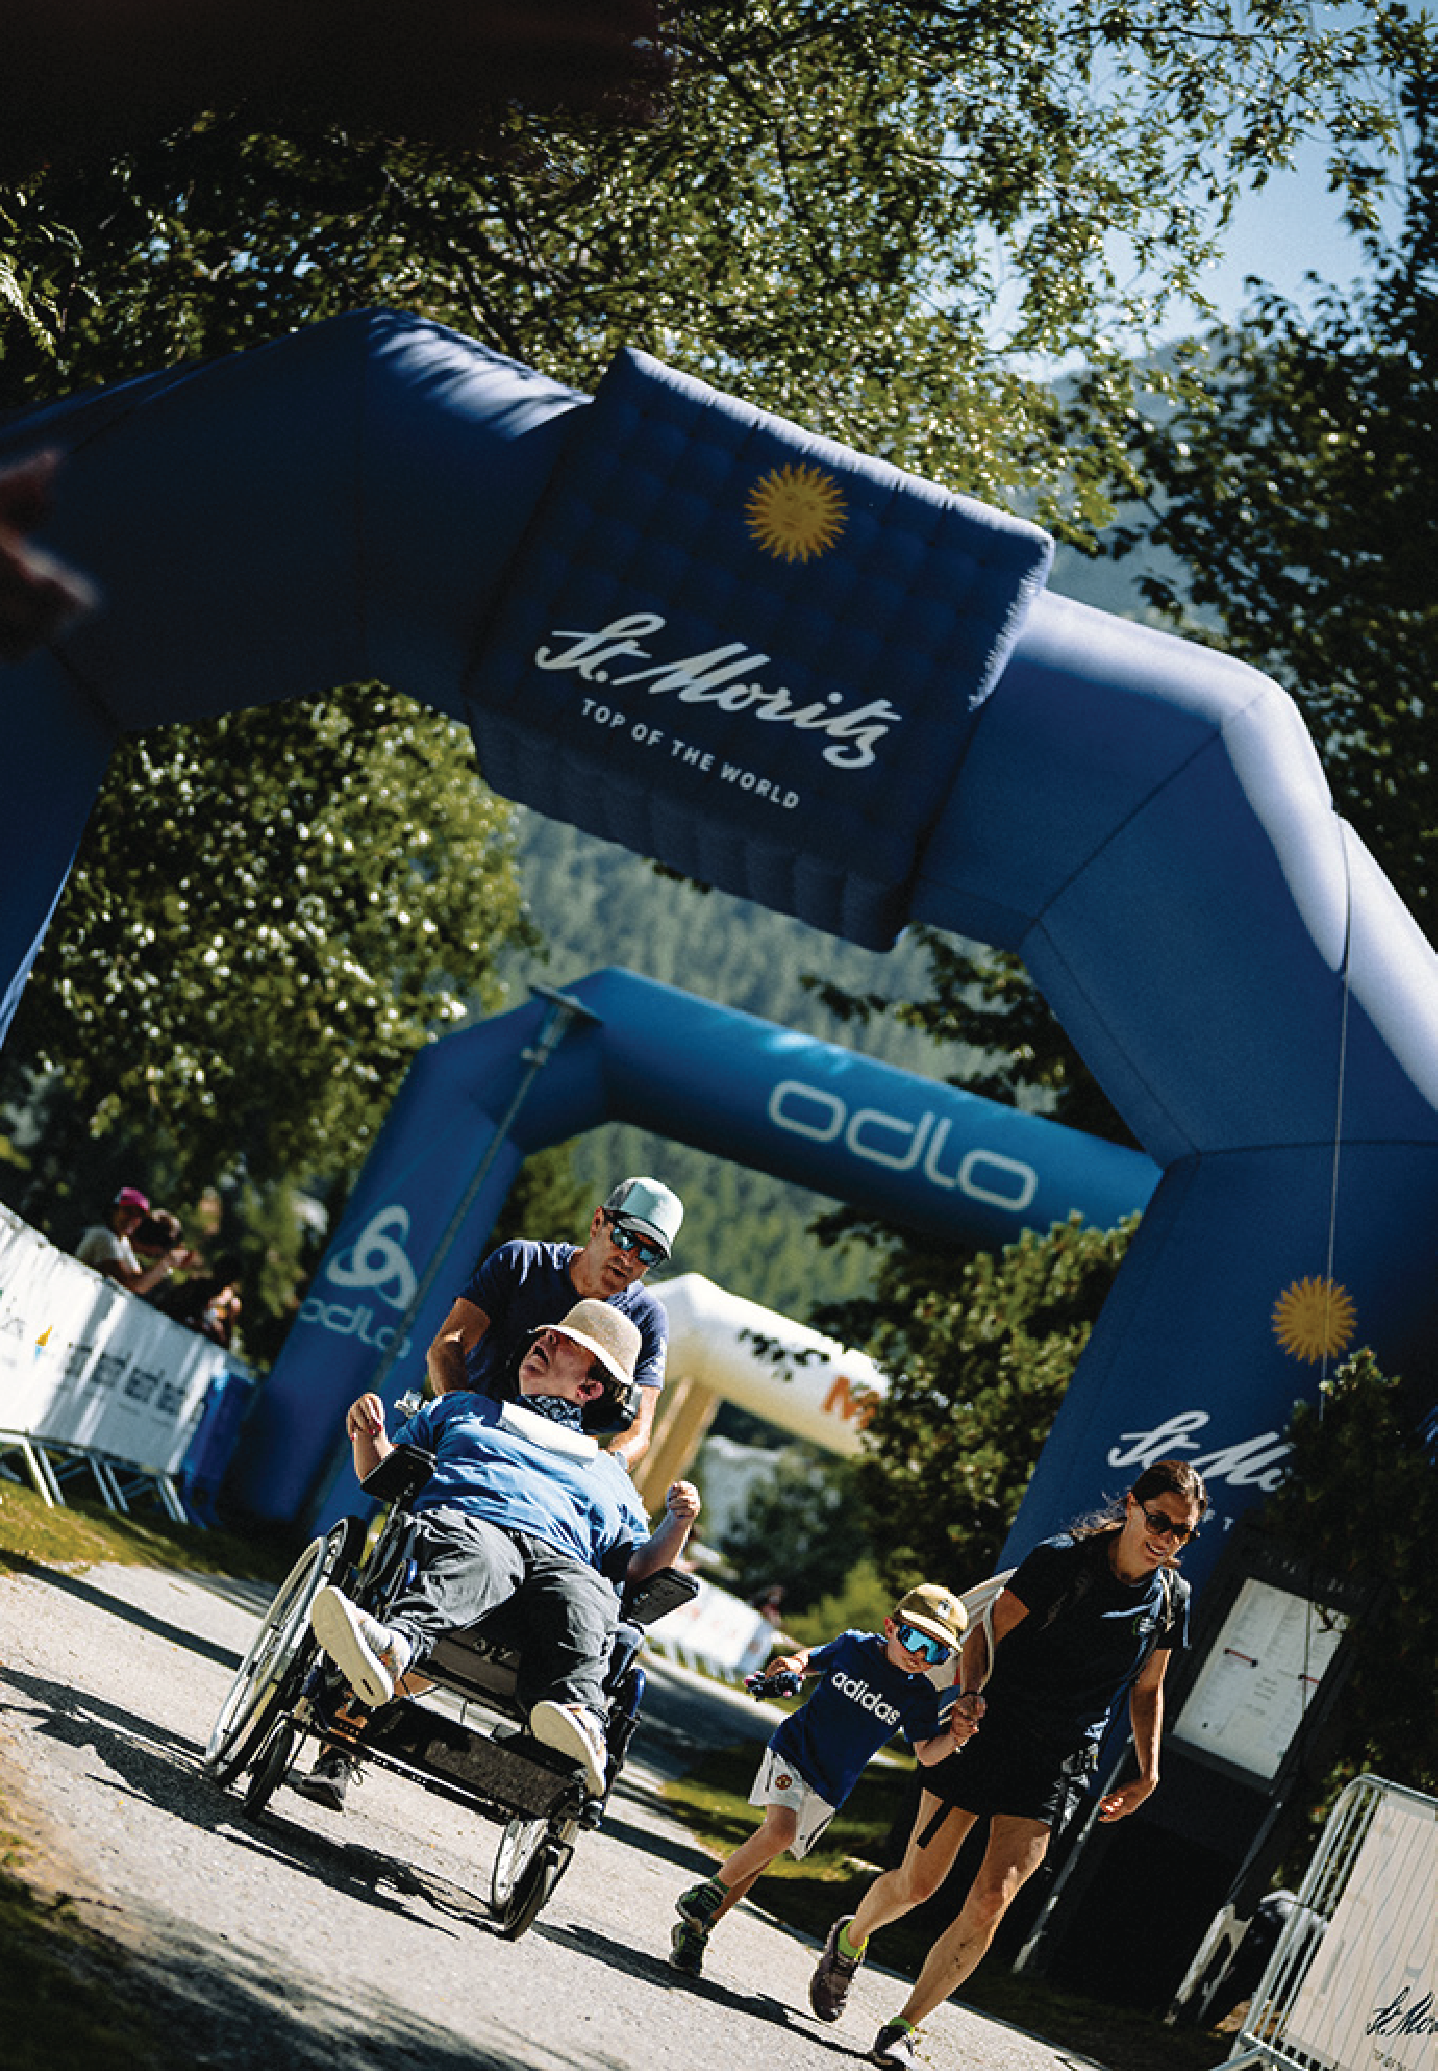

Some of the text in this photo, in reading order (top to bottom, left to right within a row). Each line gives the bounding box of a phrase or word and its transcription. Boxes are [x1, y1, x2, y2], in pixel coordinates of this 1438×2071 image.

[534, 611, 902, 769] St. Moritz
[582, 698, 800, 809] TOP OF THE WORLD
[768, 1078, 1039, 1212] odlo
[299, 1297, 413, 1359] odlo
[831, 1672, 900, 1725] adidas
